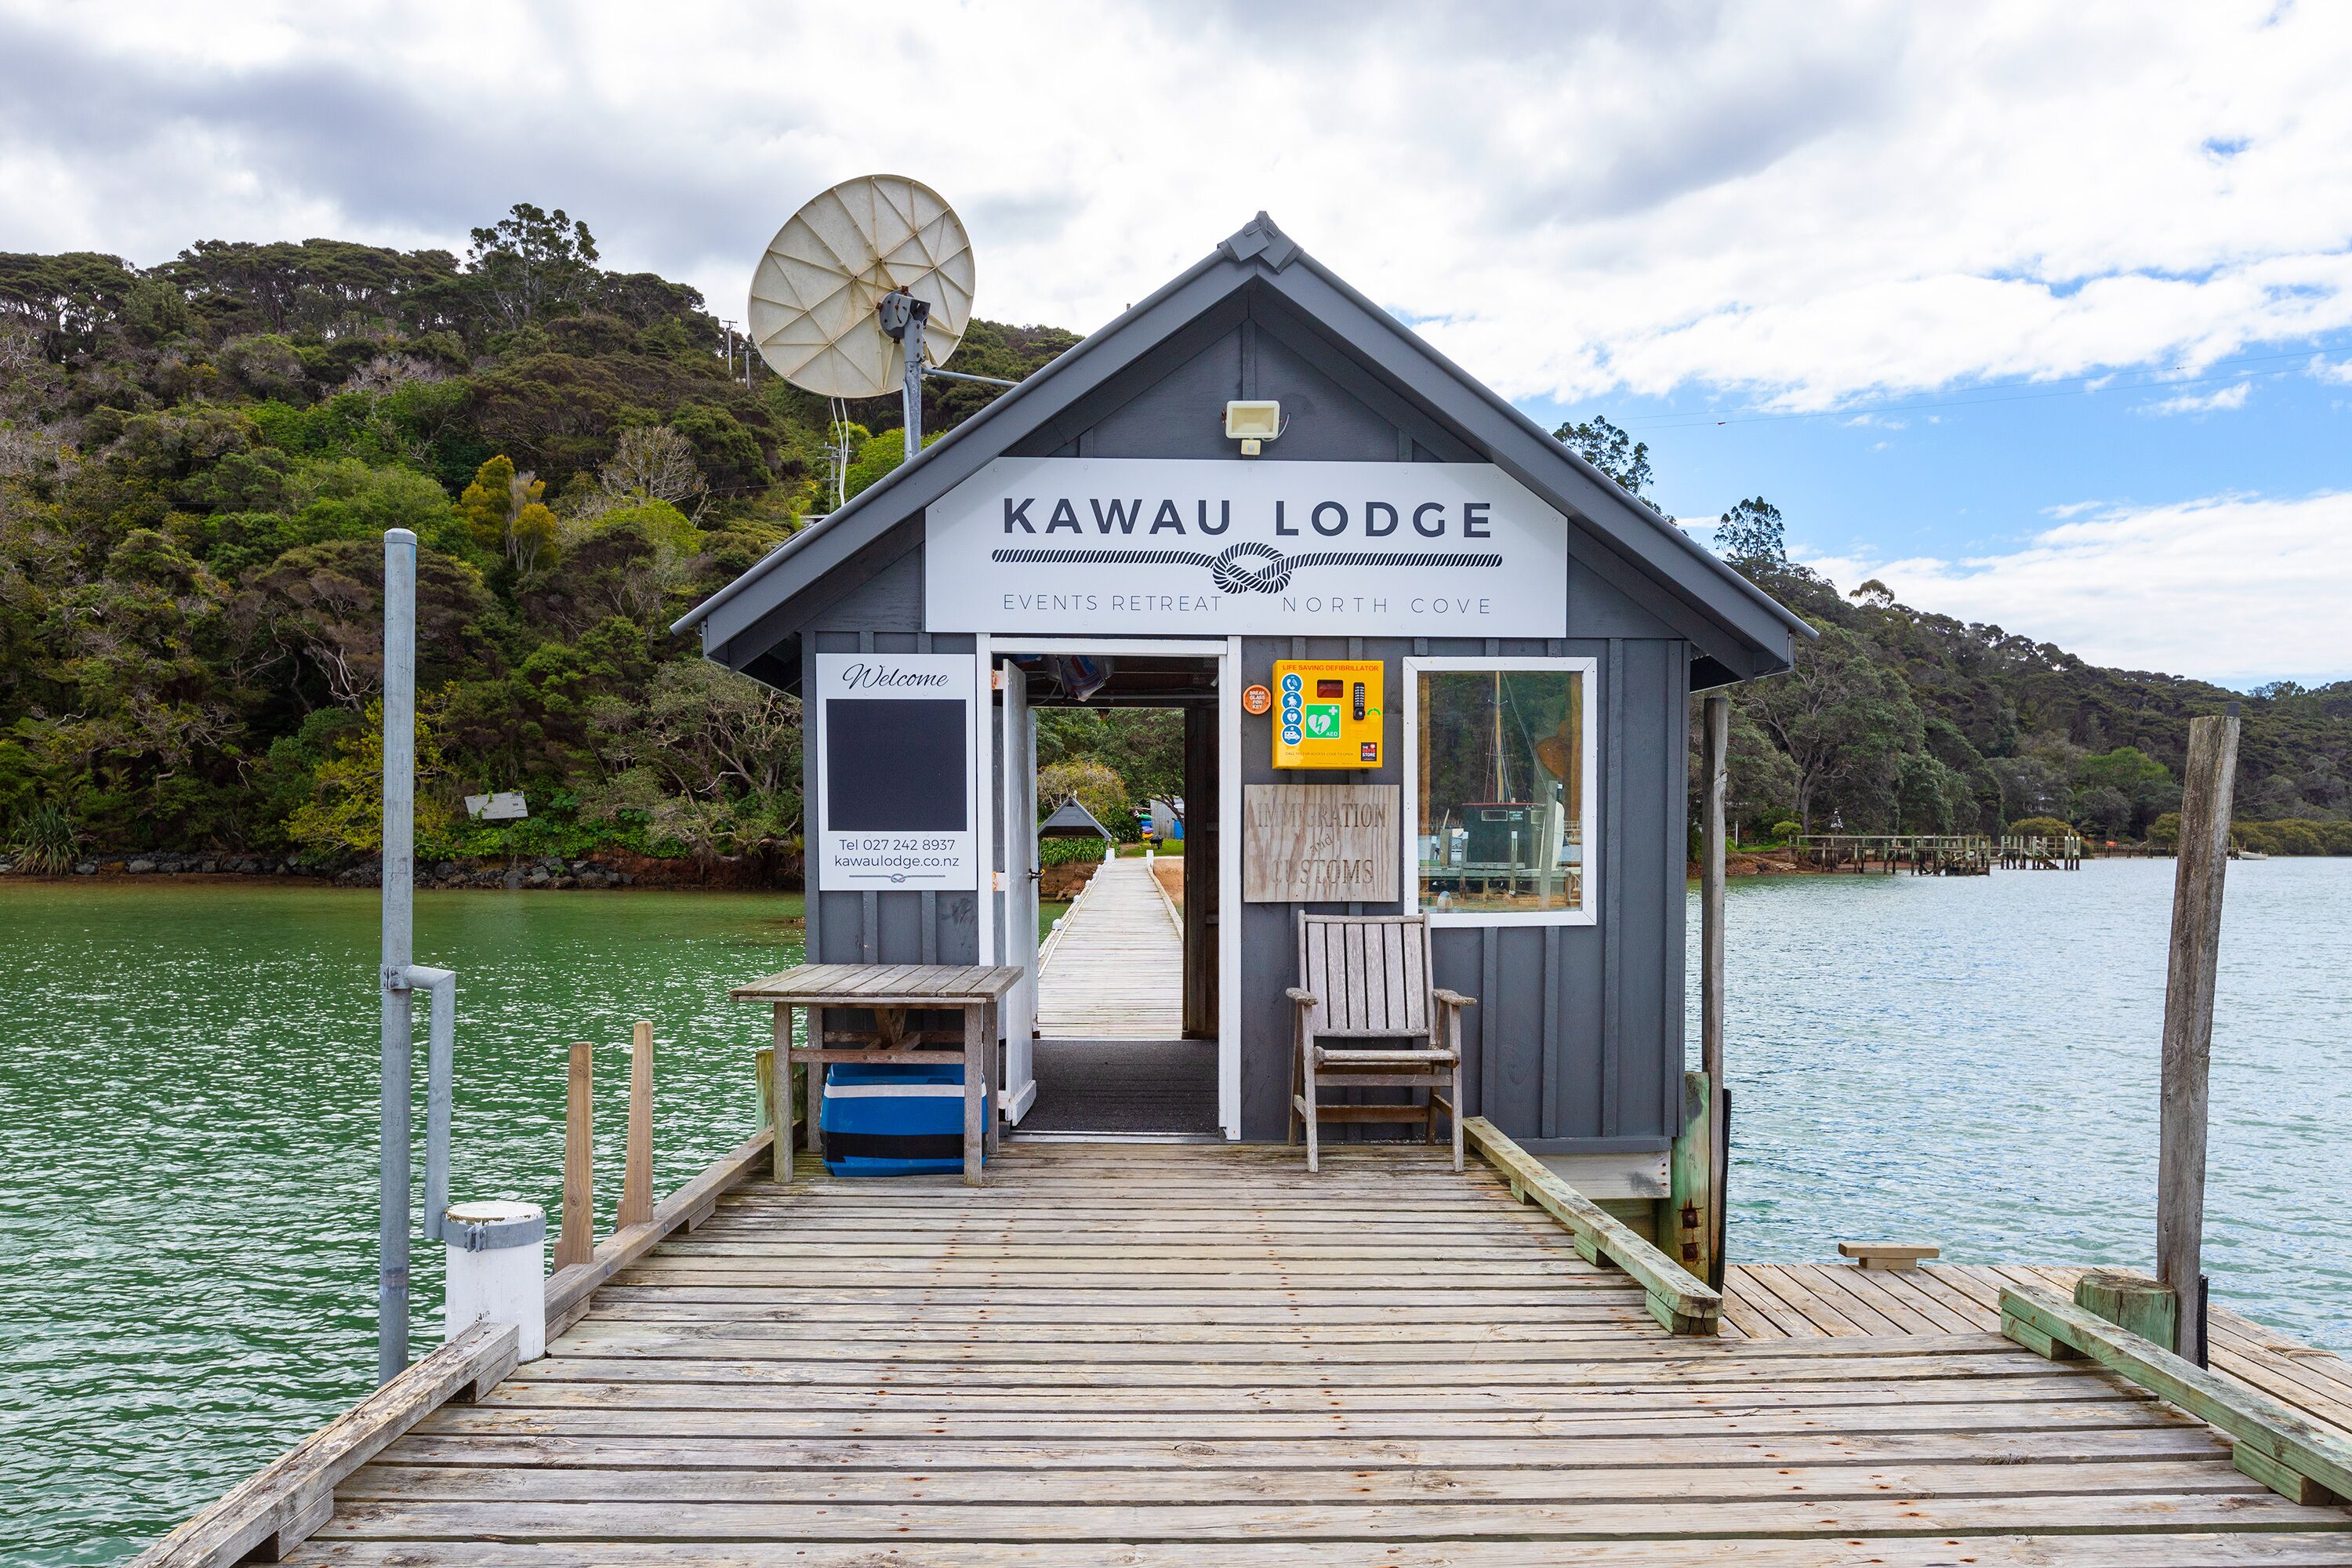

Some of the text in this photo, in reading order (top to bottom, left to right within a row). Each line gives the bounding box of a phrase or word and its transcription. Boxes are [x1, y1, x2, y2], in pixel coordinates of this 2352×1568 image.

[1004, 498, 1491, 539] KAWAU LODGE
[1004, 593, 1490, 614] EVENTS RETREAT NORTH COVE
[842, 663, 949, 690] Welcome
[1256, 802, 1387, 828] IMMIGRATION
[839, 839, 956, 851] Tel 027 242 8937
[1309, 833, 1334, 855] and
[834, 855, 960, 868] kawaulodge.co.nz
[1271, 859, 1374, 884] CUSTOMS
